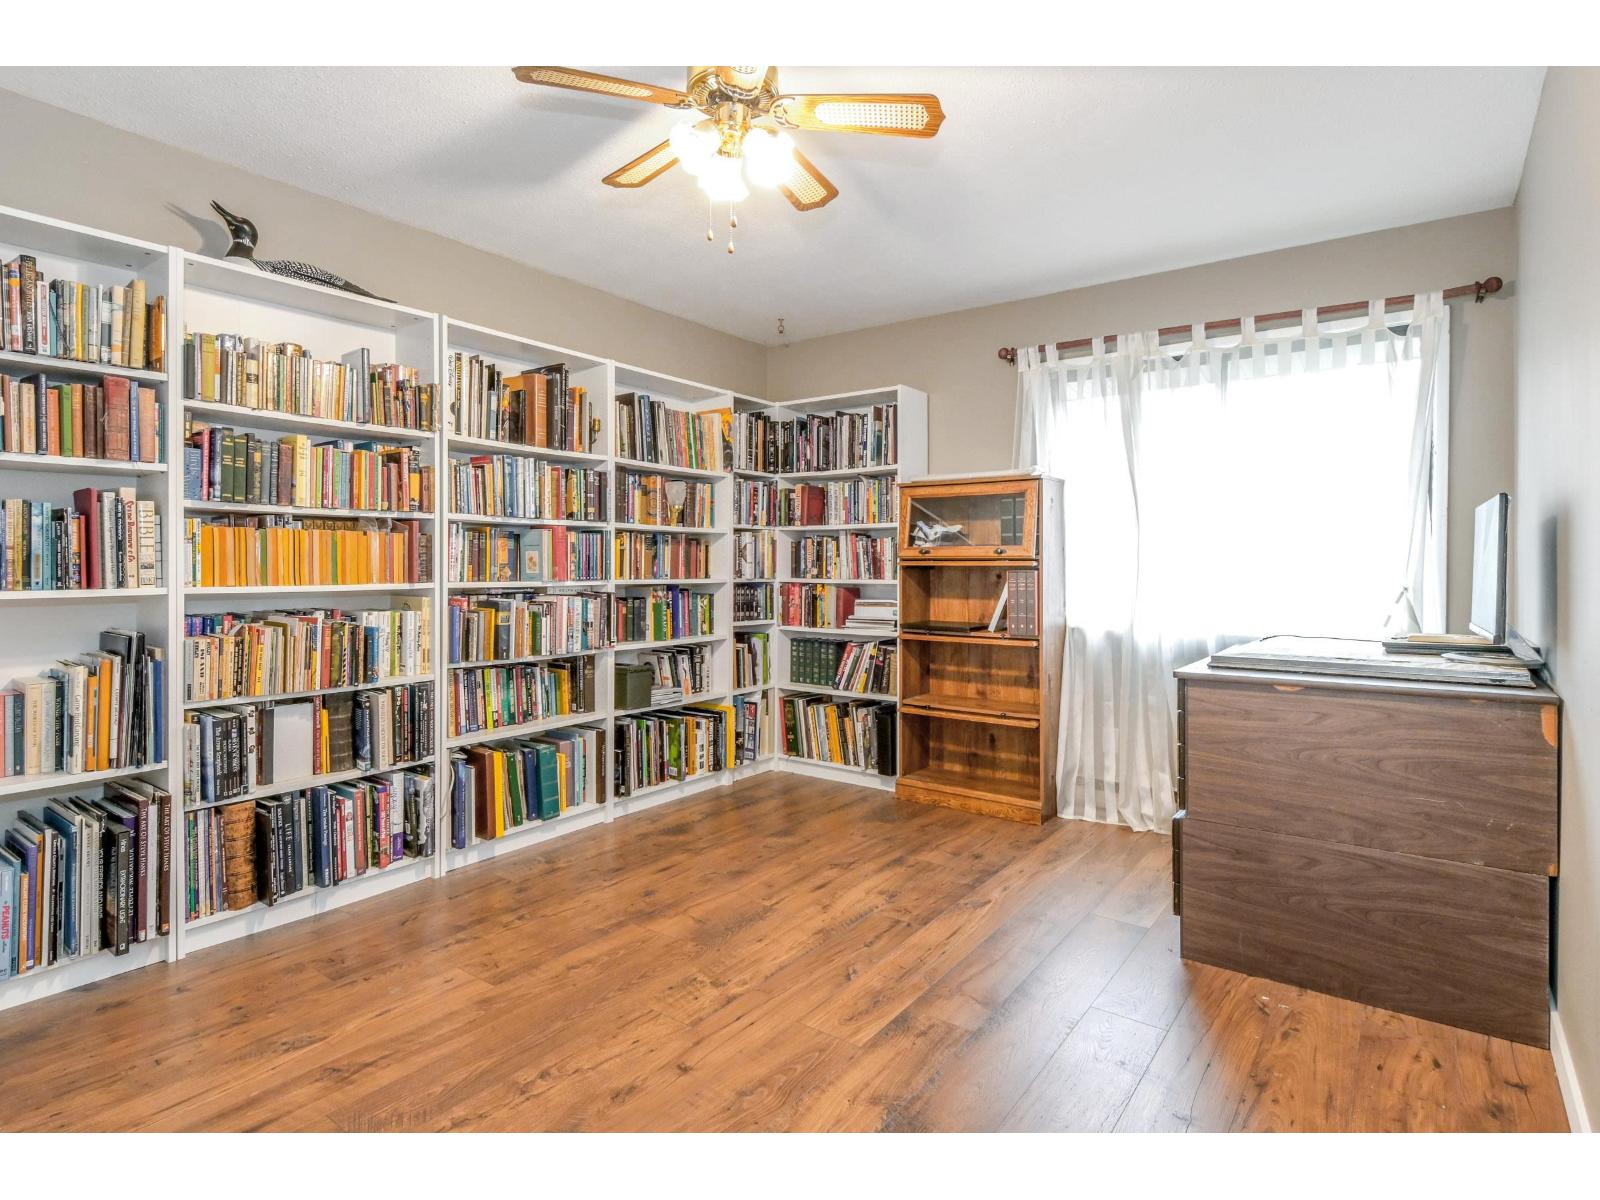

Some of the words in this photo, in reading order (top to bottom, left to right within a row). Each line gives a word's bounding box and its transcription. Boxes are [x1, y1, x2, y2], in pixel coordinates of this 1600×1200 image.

[139, 509, 154, 553] BIBLE
[140, 807, 148, 819] THE
[163, 803, 171, 815] THE
[284, 823, 293, 841] LIFE
[1, 905, 10, 941] PEANUTS
